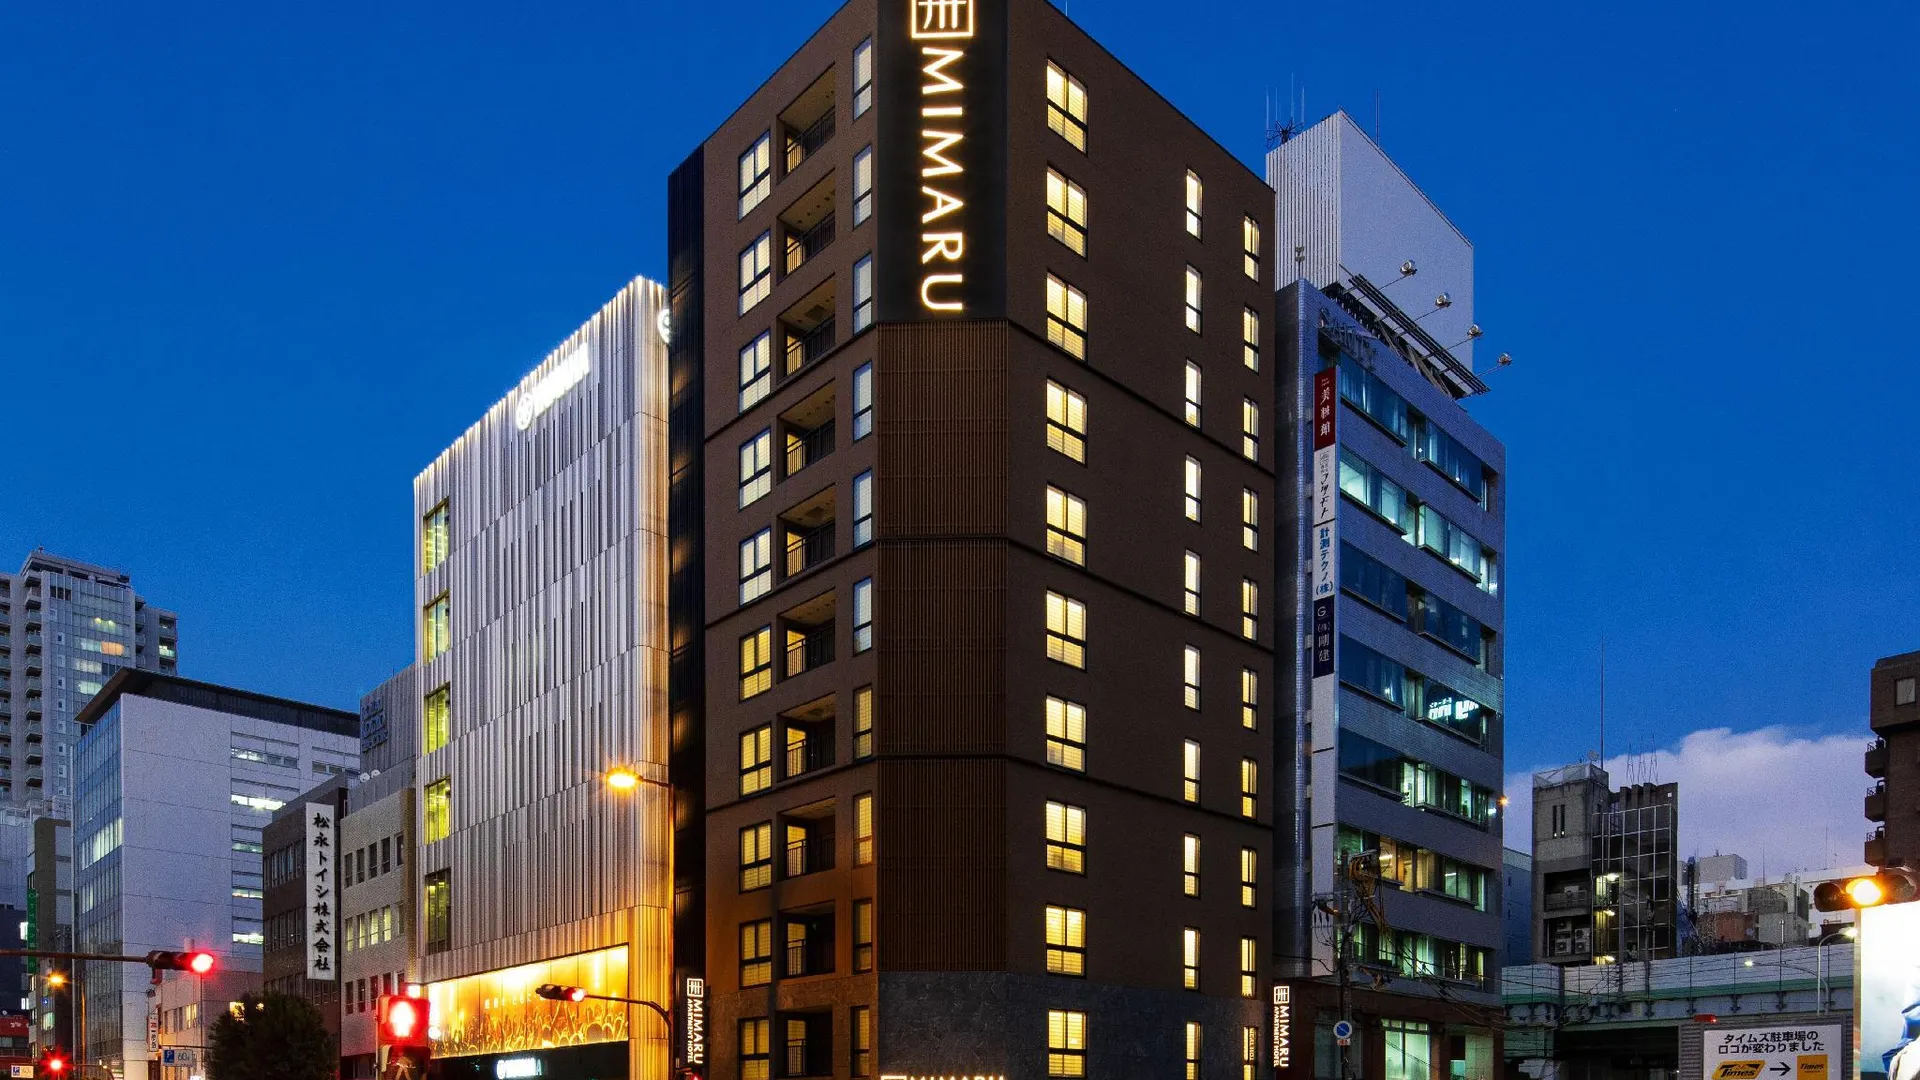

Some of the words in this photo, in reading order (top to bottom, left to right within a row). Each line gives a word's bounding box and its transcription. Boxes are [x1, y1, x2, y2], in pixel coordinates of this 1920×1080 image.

[921, 47, 964, 311] MIMARU
[312, 812, 331, 971] 松永トイシ株式会社
[693, 999, 704, 1065] MIMARU
[1279, 1005, 1290, 1067] MIMARU
[1718, 1041, 1825, 1054] ロゴが変わりました
[1723, 1030, 1819, 1044] タイムズ駐車場の
[1720, 1066, 1756, 1078] Times
